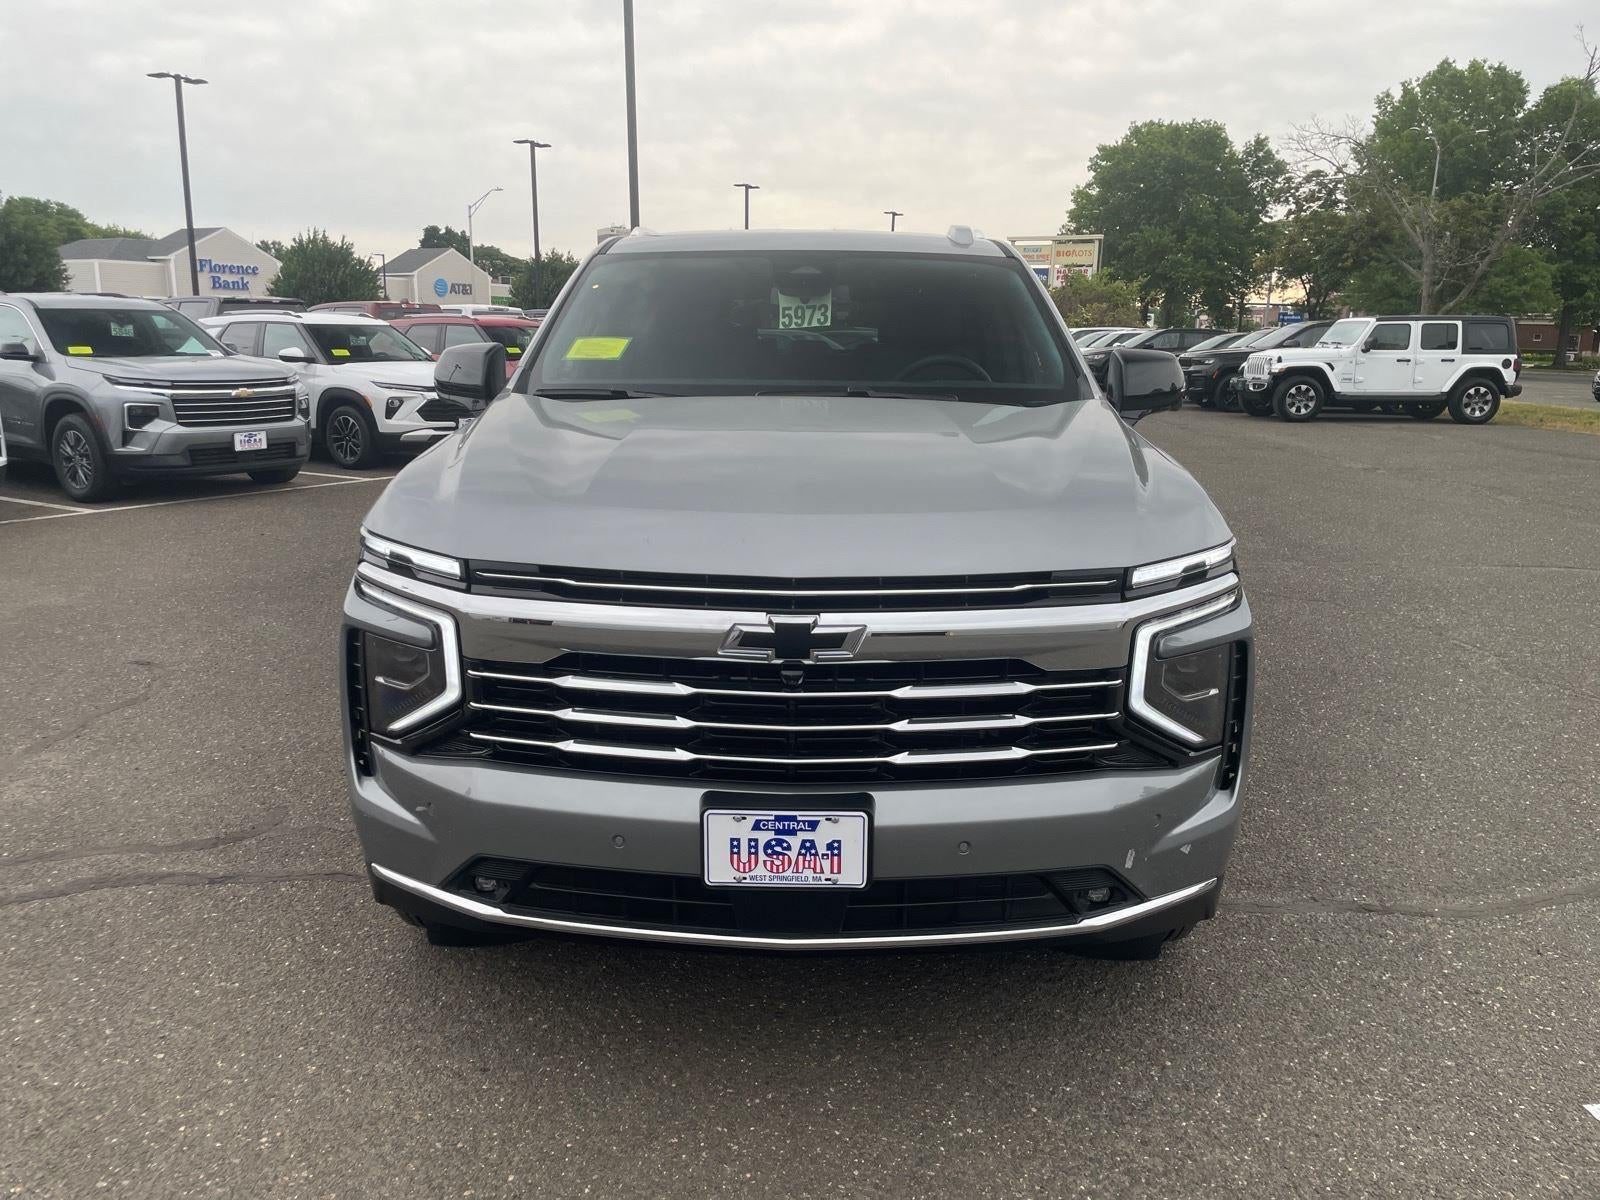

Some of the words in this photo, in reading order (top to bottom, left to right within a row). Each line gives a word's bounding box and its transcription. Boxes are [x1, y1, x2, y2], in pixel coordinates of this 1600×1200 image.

[198, 258, 259, 274] Florence
[211, 275, 250, 290] Bank
[781, 303, 829, 328] 5973
[759, 821, 812, 831] CENTRAL
[749, 874, 767, 882] WEST
[768, 874, 811, 883] SPRINGFIELD,
